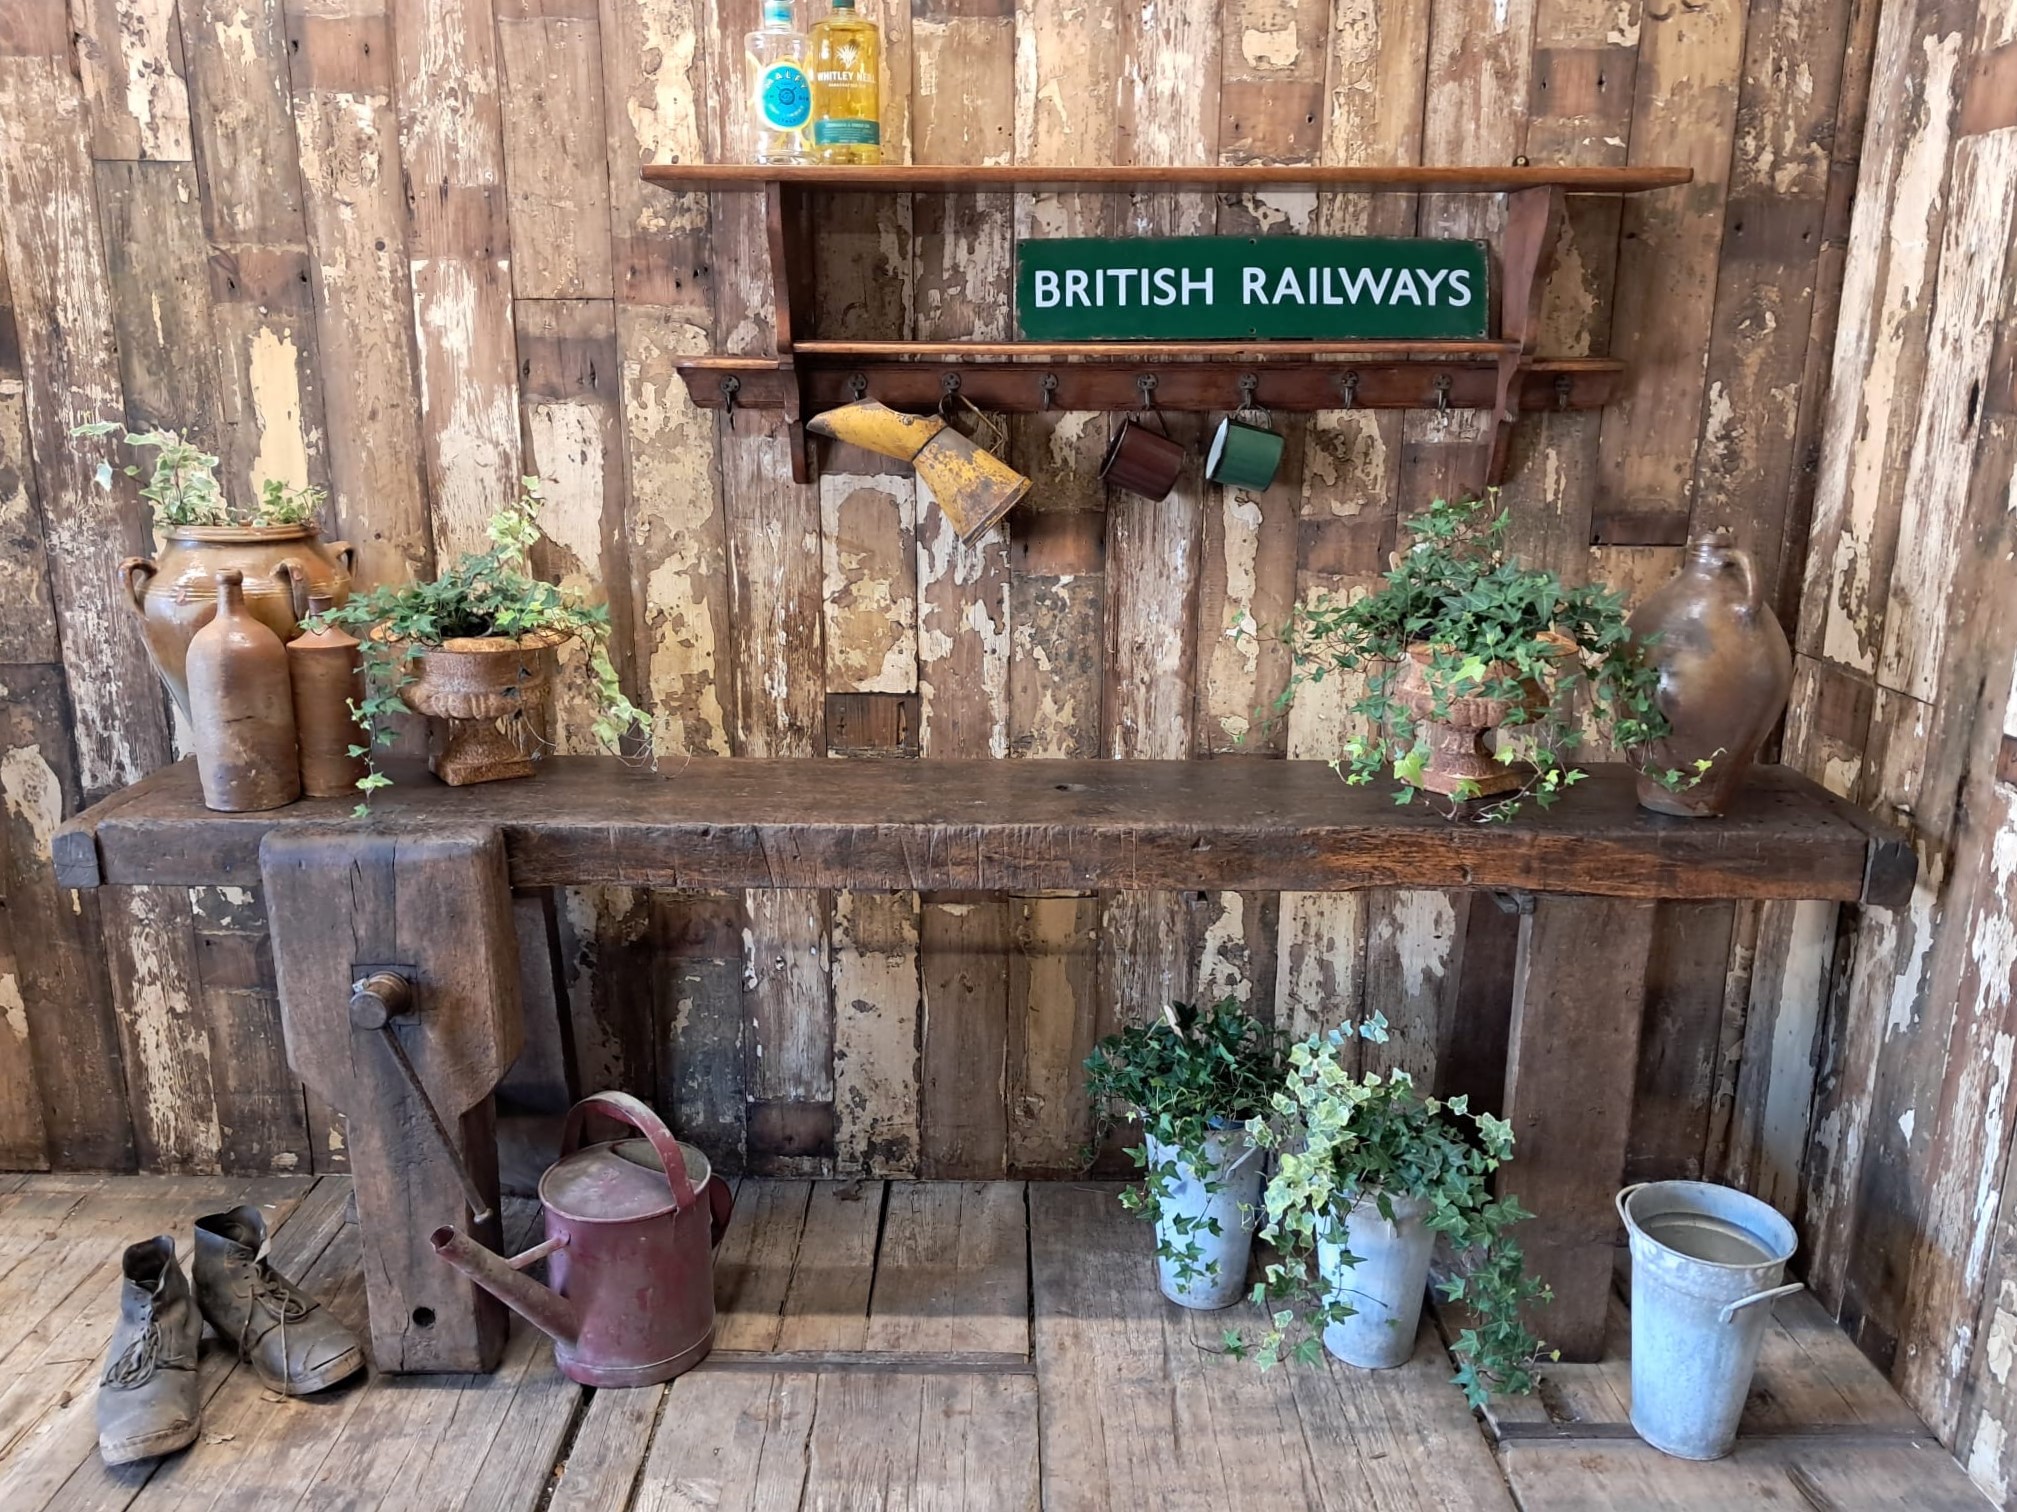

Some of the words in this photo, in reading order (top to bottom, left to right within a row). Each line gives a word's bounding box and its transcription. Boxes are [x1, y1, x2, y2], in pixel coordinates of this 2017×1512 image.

[817, 70, 854, 82] WHITLEY
[1034, 268, 1214, 307] BRITISH
[1242, 267, 1472, 307] RAILWAYS
